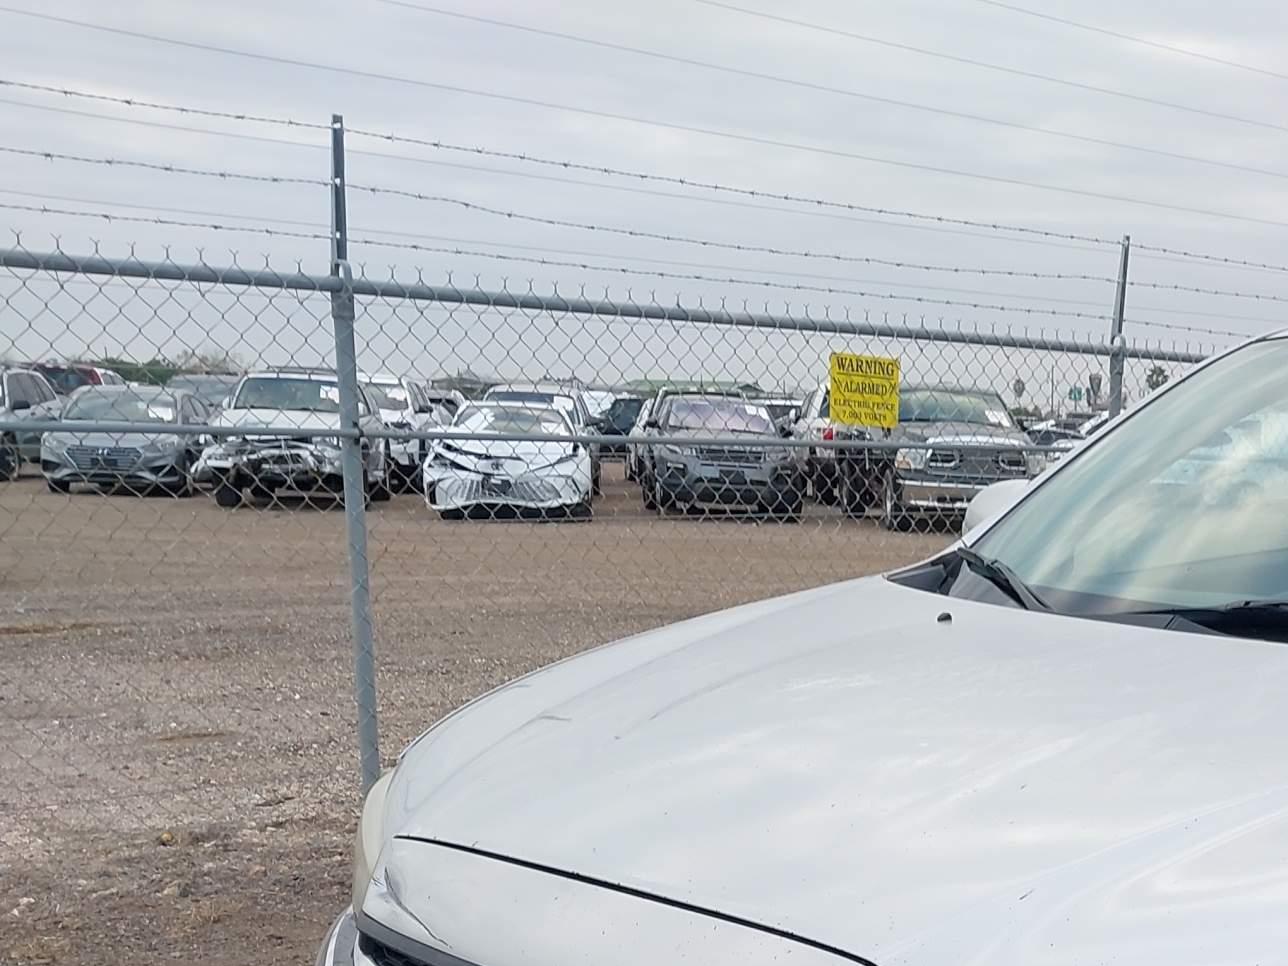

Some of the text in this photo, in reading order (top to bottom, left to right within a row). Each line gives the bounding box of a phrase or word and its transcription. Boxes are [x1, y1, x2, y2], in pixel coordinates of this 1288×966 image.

[836, 356, 894, 377] WARNING
[843, 381, 888, 397] ALARMED
[872, 400, 896, 412] FENCE
